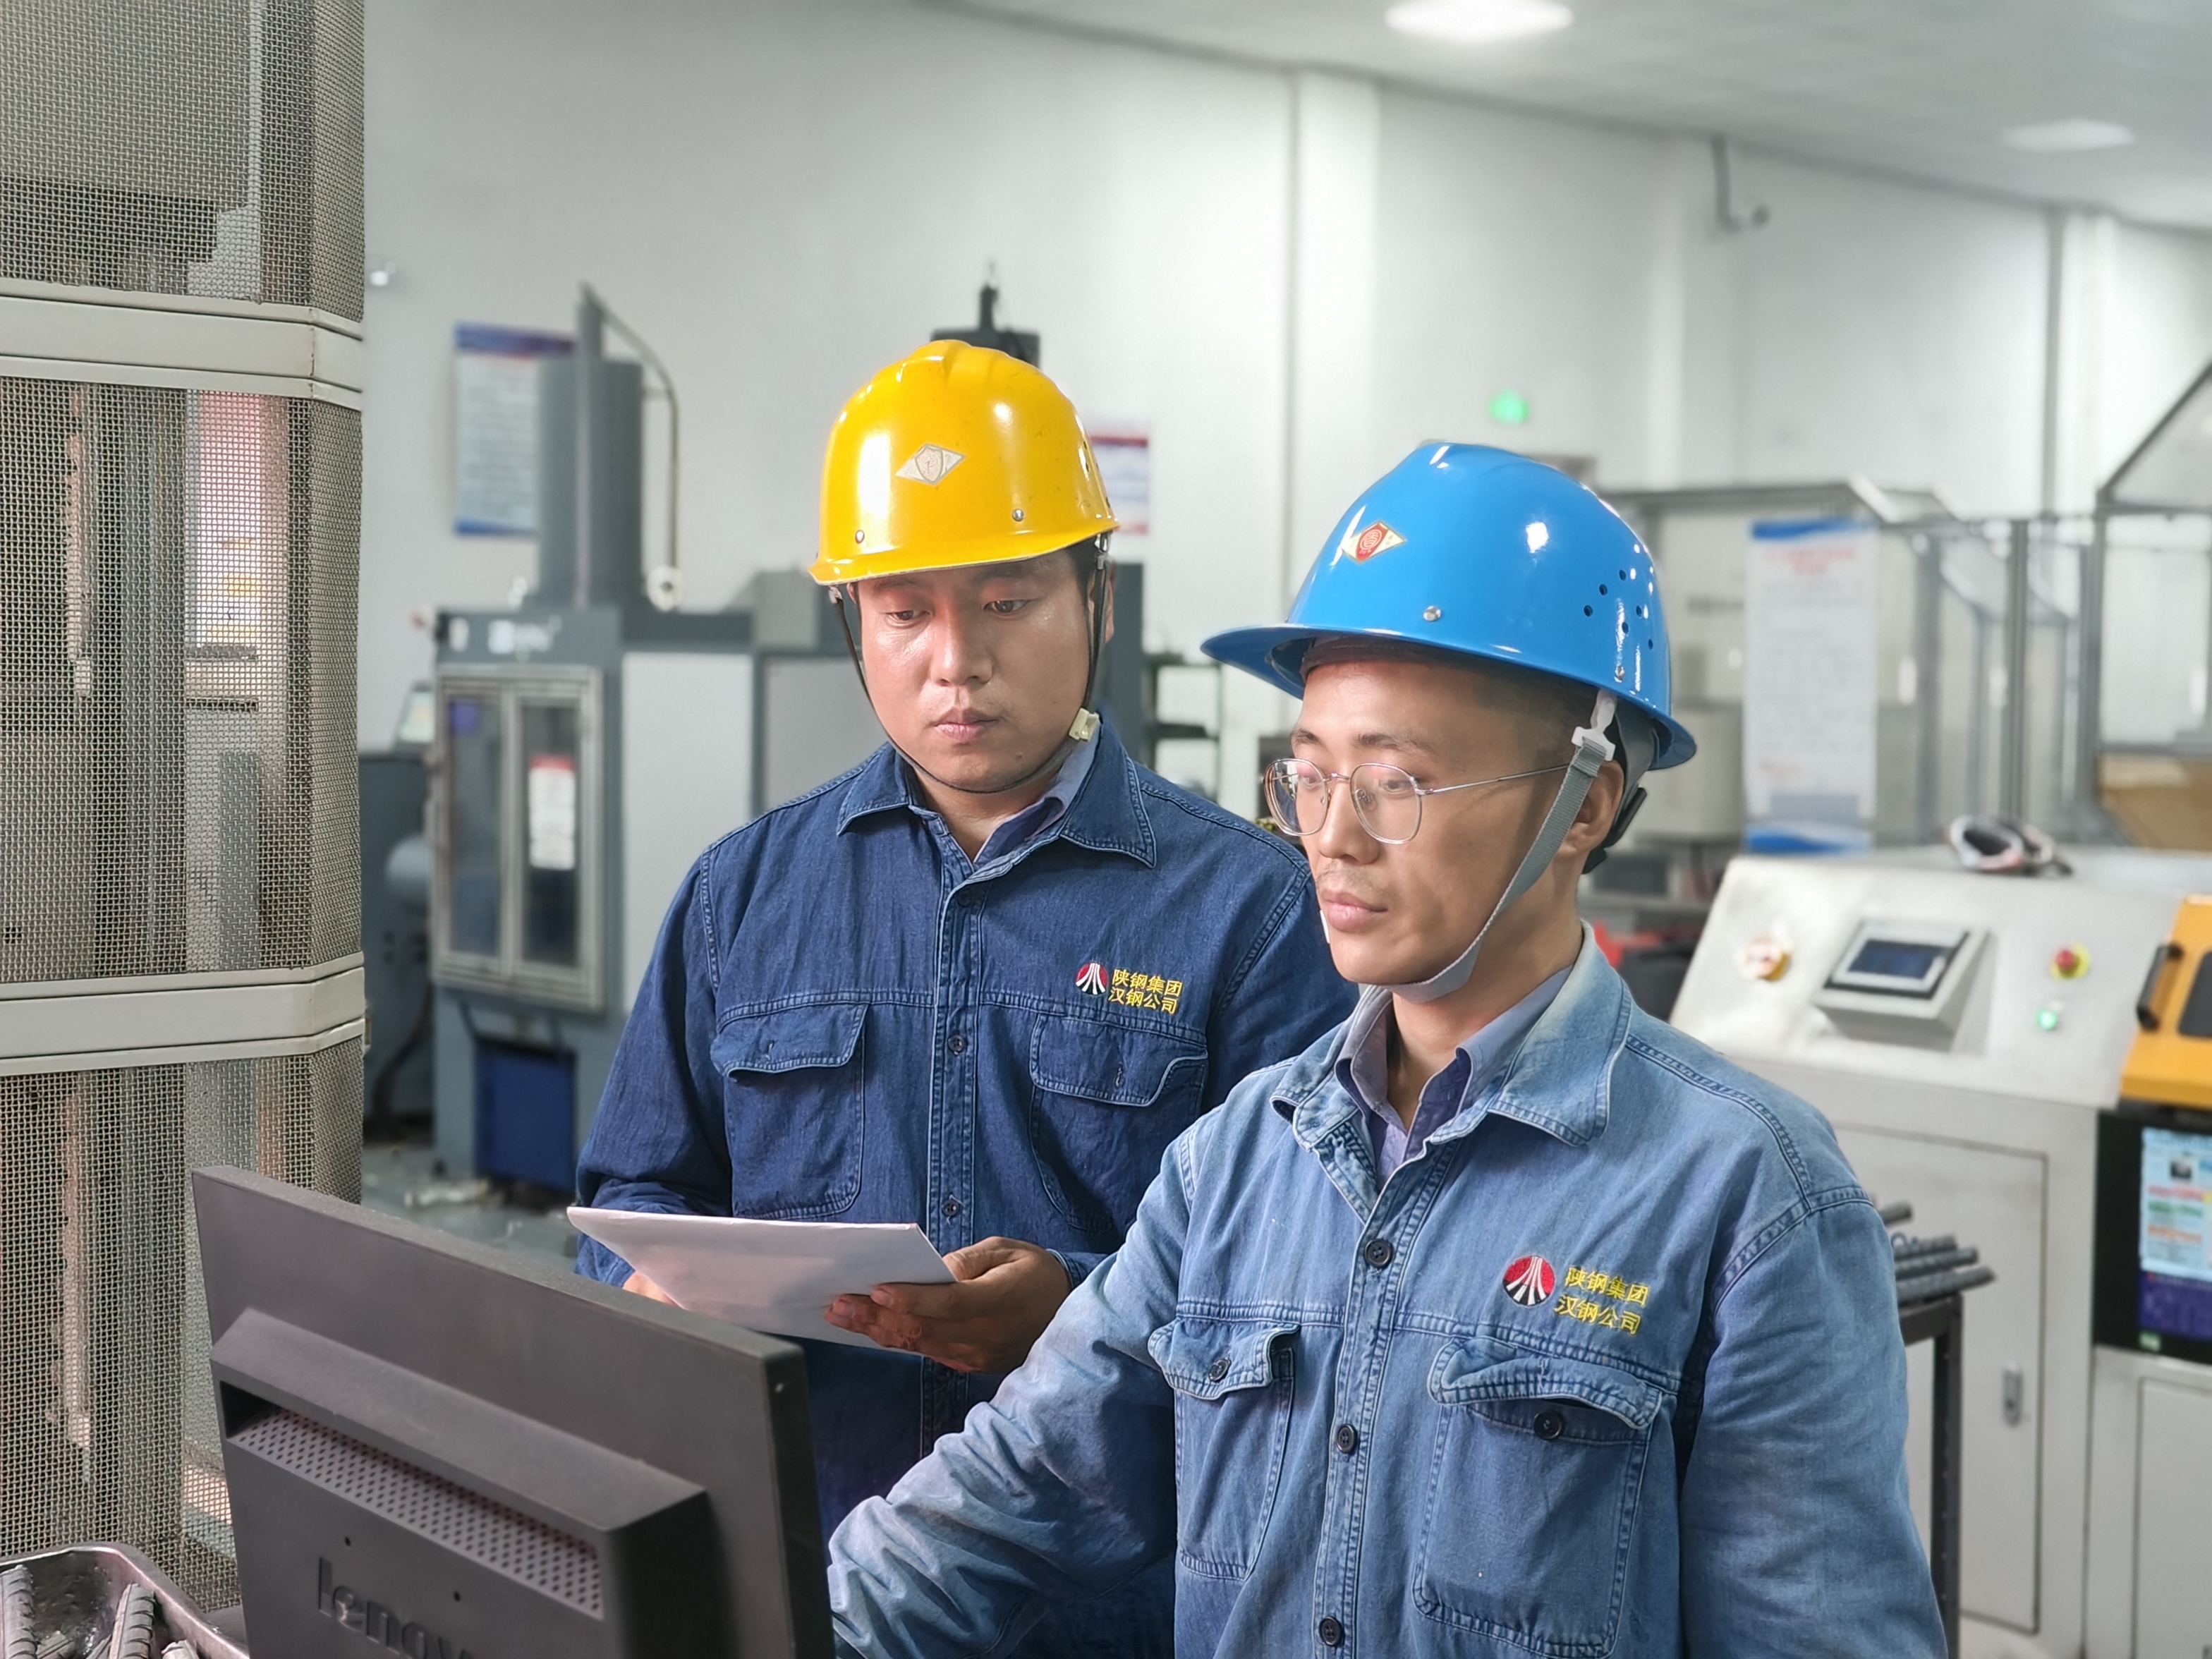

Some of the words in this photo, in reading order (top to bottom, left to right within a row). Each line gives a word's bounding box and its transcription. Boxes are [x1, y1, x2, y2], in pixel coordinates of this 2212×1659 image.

[1108, 986, 1178, 1014] 汉钢公司
[1112, 968, 1183, 997] 陕钢集团
[1564, 1266, 1650, 1307] 陕钢集团
[1554, 1294, 1641, 1335] 汉钢公司
